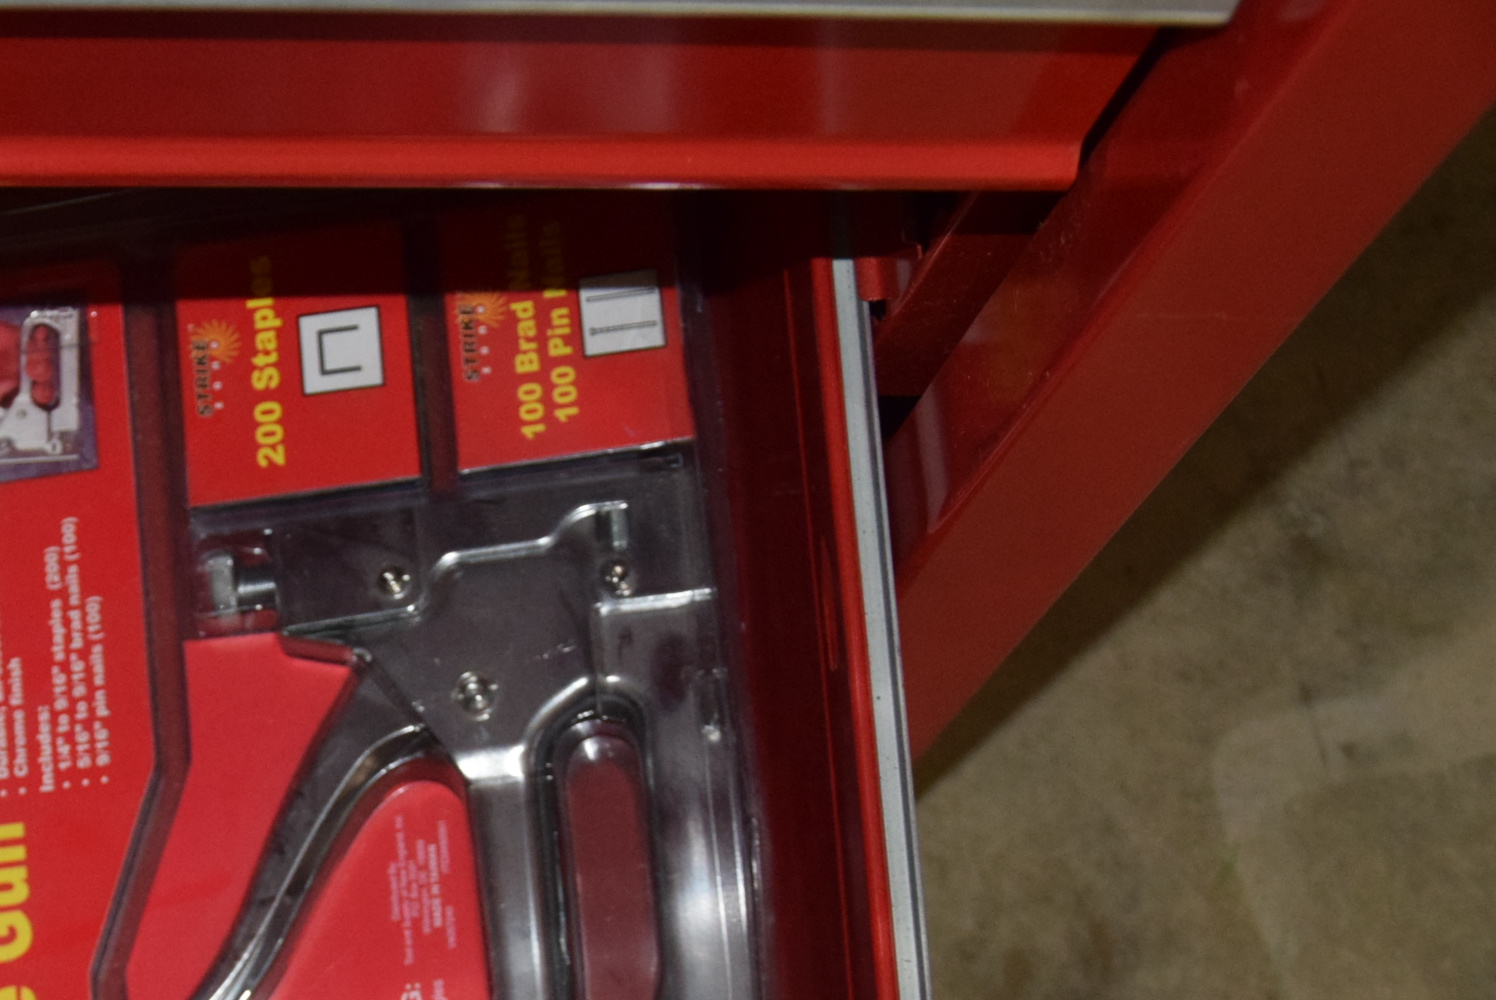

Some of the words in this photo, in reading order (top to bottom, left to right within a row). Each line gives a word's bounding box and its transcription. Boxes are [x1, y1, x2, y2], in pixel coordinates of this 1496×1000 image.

[245, 256, 284, 390] Staples
[459, 305, 481, 382] STRIKE
[509, 300, 541, 374] Brad
[546, 307, 574, 357] Pin
[193, 338, 213, 418] STRIKE
[550, 365, 580, 422] 100
[253, 401, 286, 468] 200
[517, 383, 546, 438] 100
[62, 517, 80, 560] (100)
[44, 546, 62, 590] (200)
[65, 565, 80, 606] nails
[49, 599, 66, 661] staples
[68, 610, 84, 649] brad
[86, 596, 105, 640] (100)
[8, 657, 23, 706] finish
[90, 644, 106, 686] nails
[56, 714, 70, 733] to
[74, 702, 88, 720] to
[94, 690, 110, 717] pin
[14, 710, 28, 777] Chrome
[36, 706, 55, 792] Includes:
